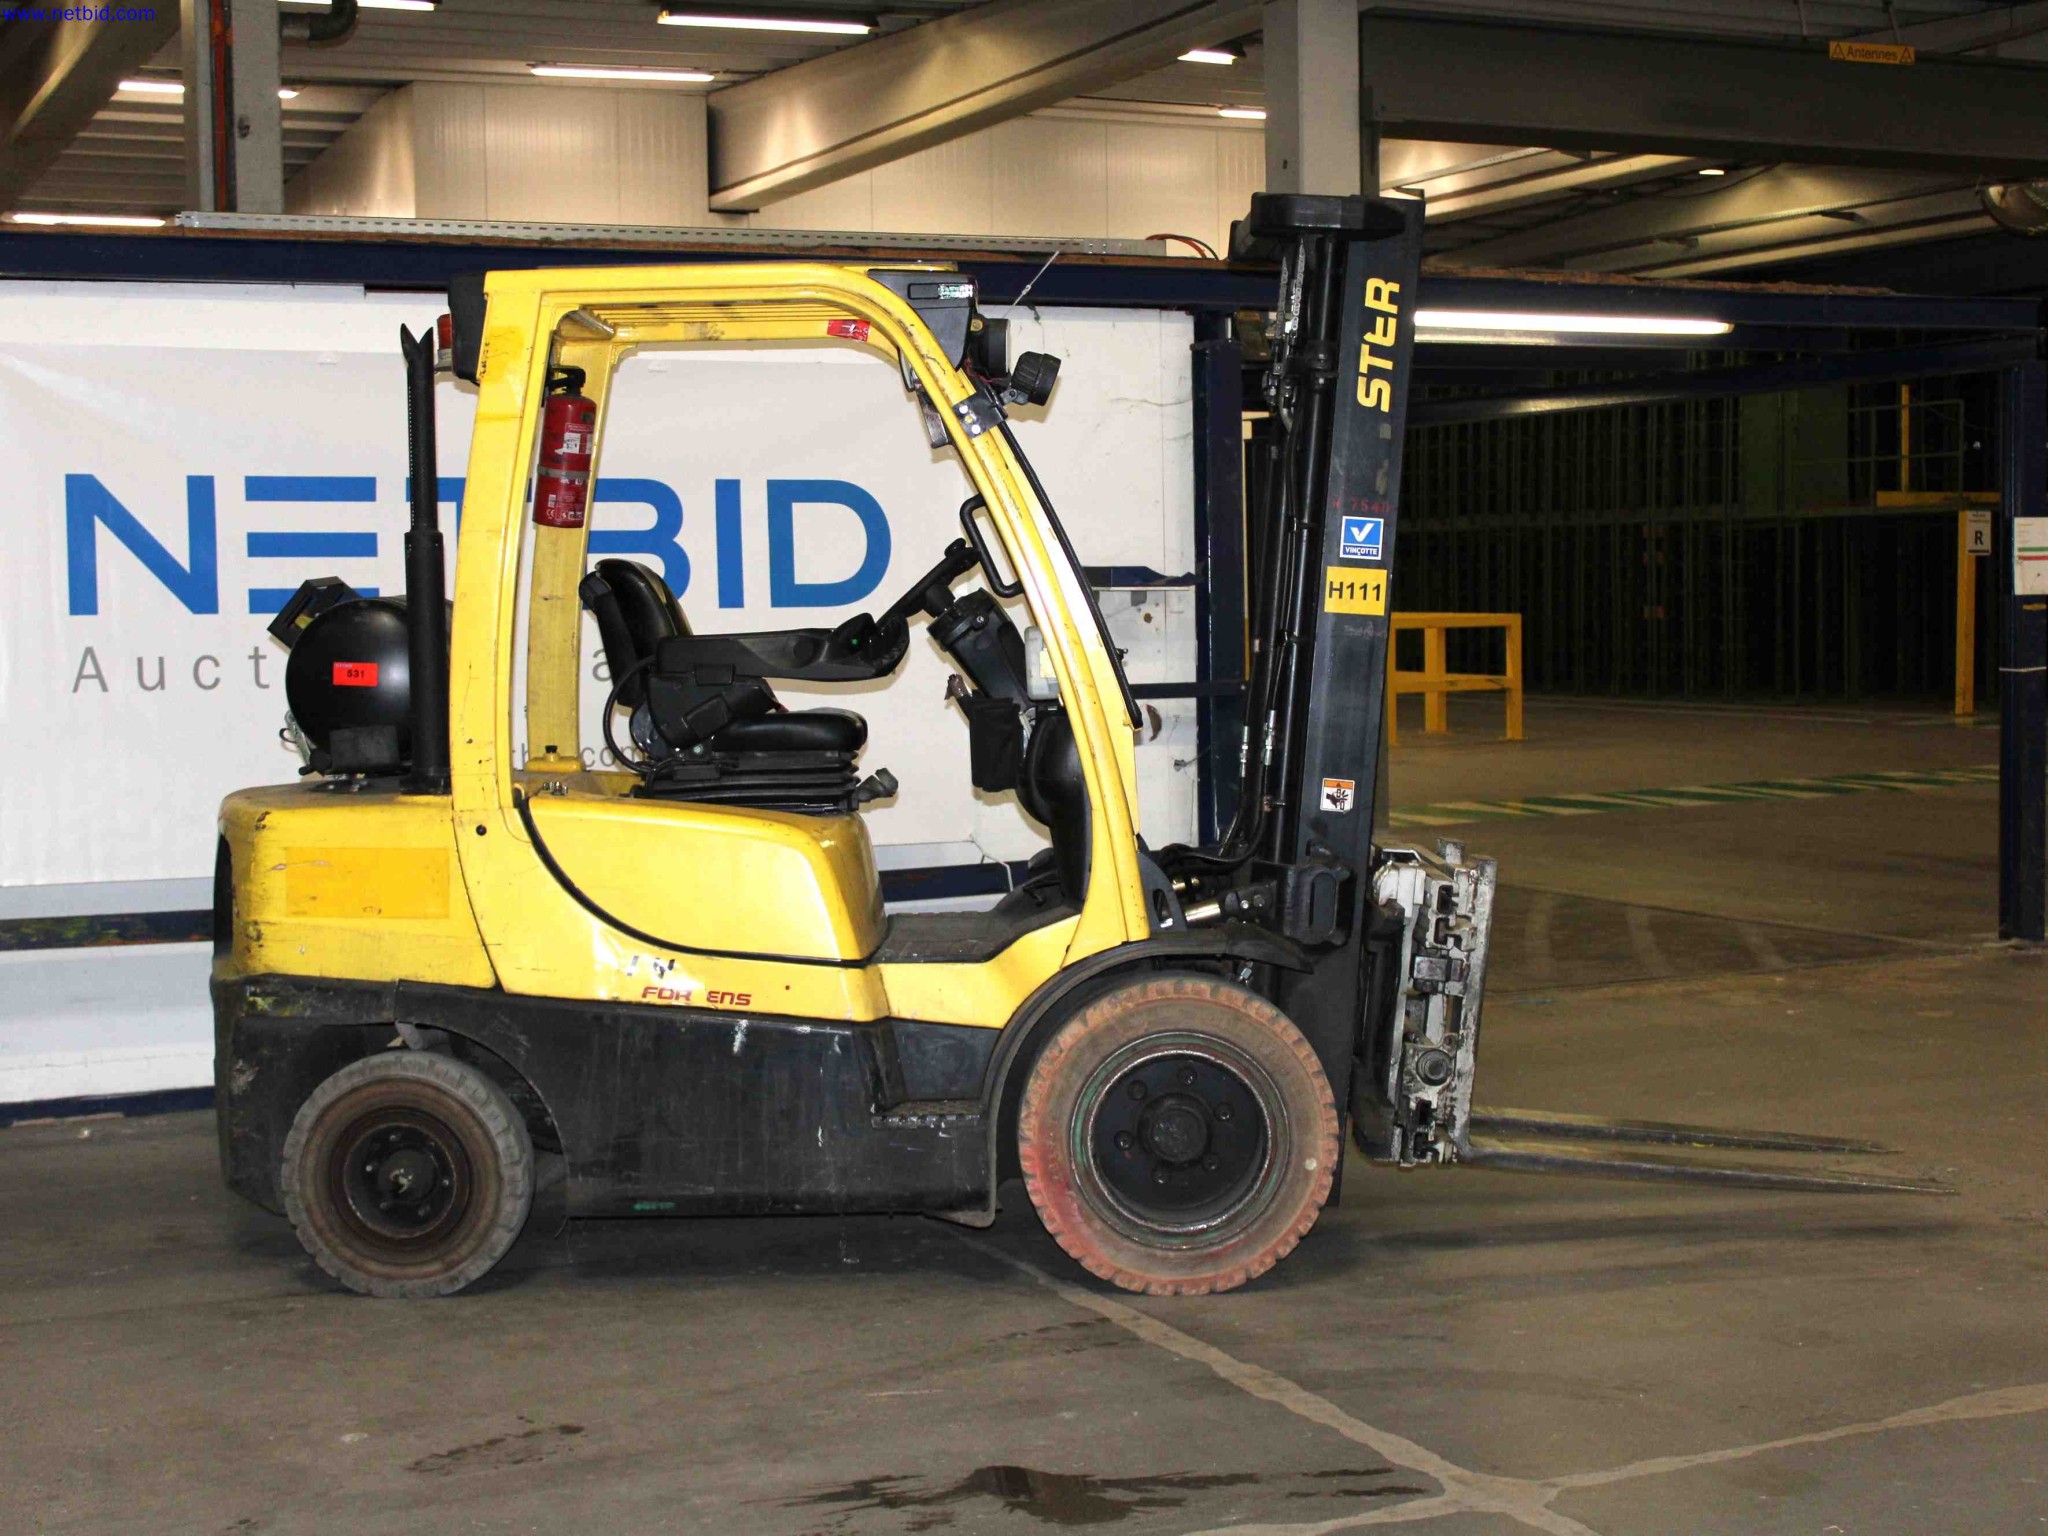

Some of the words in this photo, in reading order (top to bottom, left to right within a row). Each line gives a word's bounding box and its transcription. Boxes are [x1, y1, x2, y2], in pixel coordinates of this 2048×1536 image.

[1847, 45, 1897, 60] Antennes
[1974, 530, 1984, 545] R
[1345, 546, 1378, 556] VINÇOTTE
[1328, 580, 1381, 601] H111
[346, 669, 365, 678] 531
[642, 986, 752, 1006] FORENS
